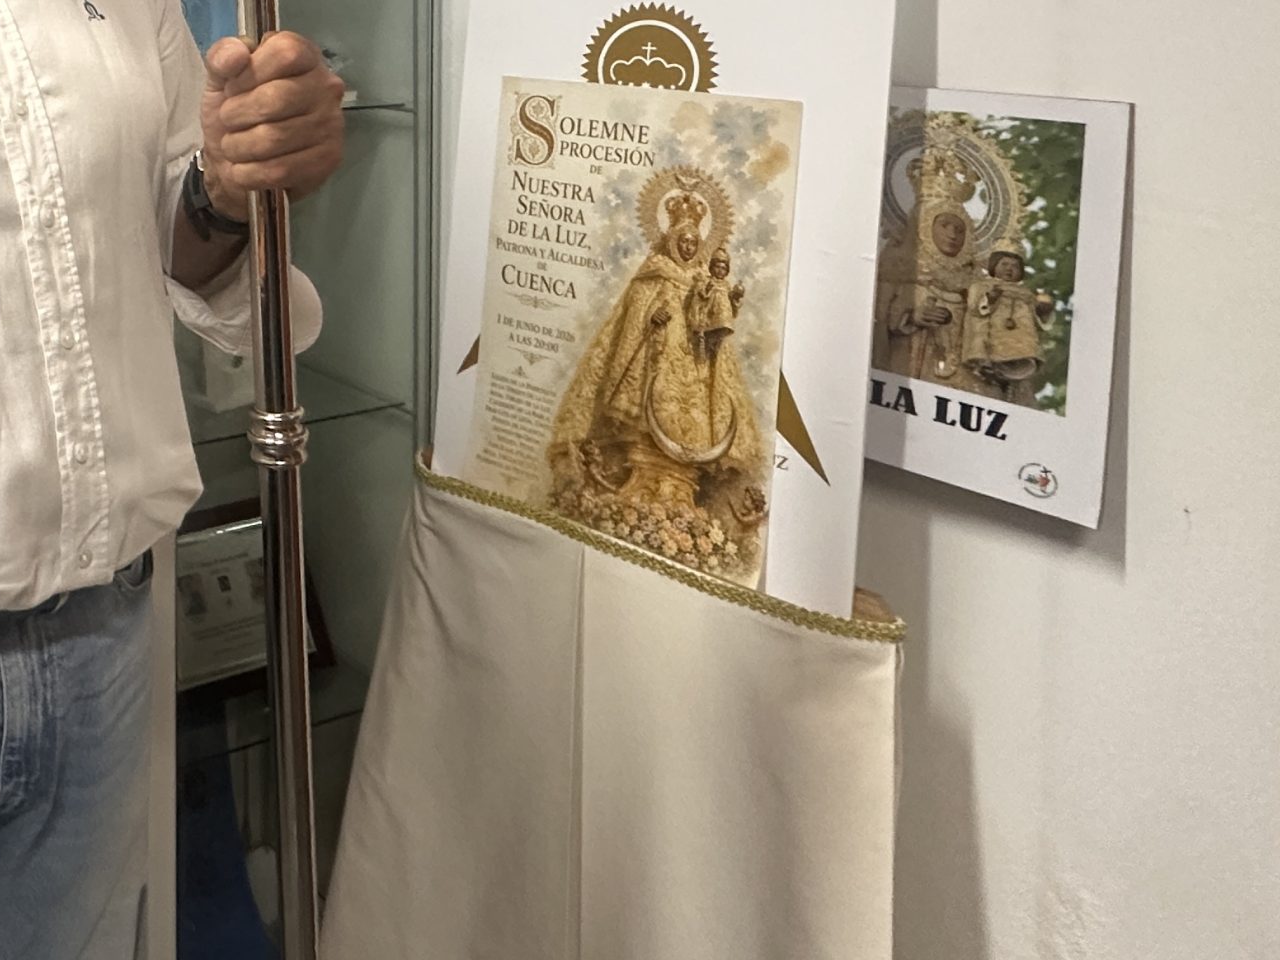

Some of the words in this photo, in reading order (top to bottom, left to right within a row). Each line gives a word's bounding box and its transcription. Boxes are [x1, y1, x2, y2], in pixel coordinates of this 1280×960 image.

[560, 140, 655, 167] PROCESIÓN
[590, 164, 603, 175] DE
[512, 170, 595, 203] NUESTRA
[516, 195, 586, 226] SEÑORA
[508, 219, 527, 237] DE
[532, 224, 551, 242] LA
[555, 224, 592, 250] LUZ,
[496, 237, 537, 256] PATRONA
[539, 248, 546, 259] Y
[547, 248, 605, 271] ALCALDESA
[501, 264, 577, 299] CUENCA
[503, 315, 514, 327] DE
[516, 319, 540, 334] JUNIO
[542, 326, 554, 337] DE
[509, 332, 515, 342] A
[516, 334, 532, 346] LAS
[869, 378, 918, 416] LA
[932, 395, 1009, 441] LUZ
